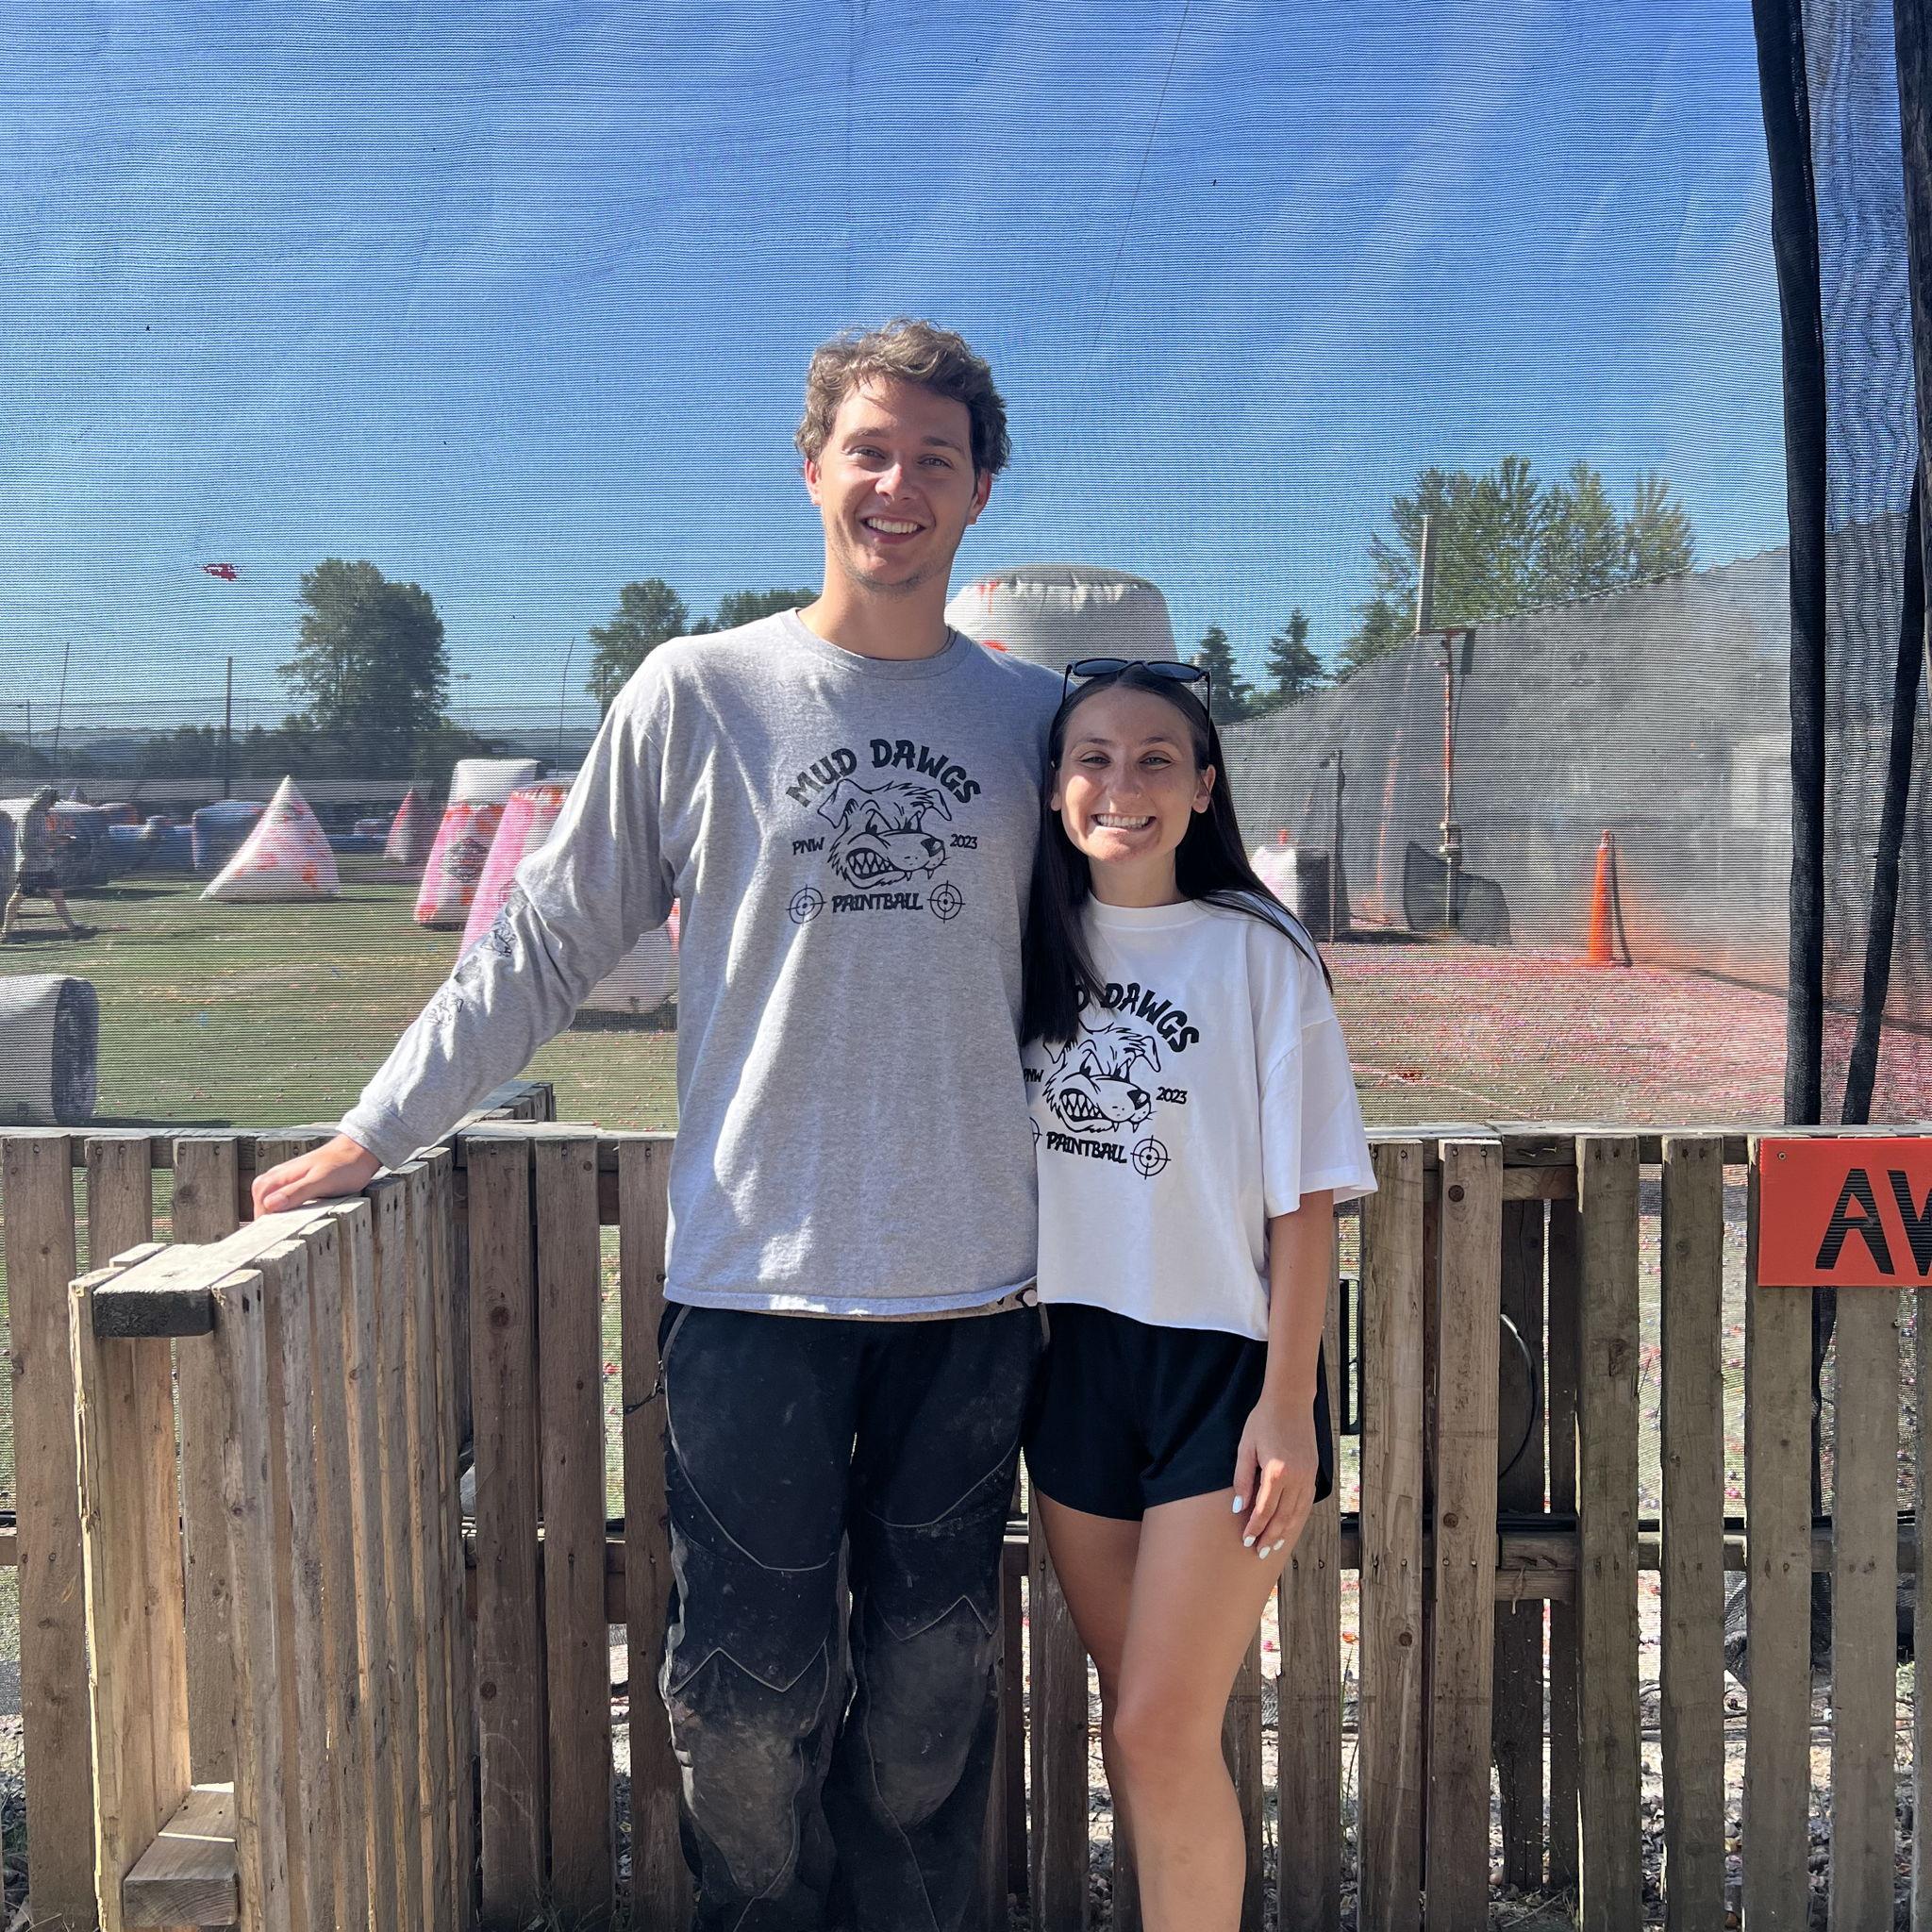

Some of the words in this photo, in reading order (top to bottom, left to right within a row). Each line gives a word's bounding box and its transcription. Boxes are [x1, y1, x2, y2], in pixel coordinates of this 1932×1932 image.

[786, 748, 858, 808] MUD
[870, 739, 981, 804] DAWGS
[792, 837, 825, 855] PNW
[949, 834, 978, 849] 2023
[831, 892, 924, 913] PAINTBALL
[1100, 982, 1200, 1053] DAWGS
[1156, 1086, 1188, 1105] 2023
[1046, 1131, 1127, 1164] PAINTBALL
